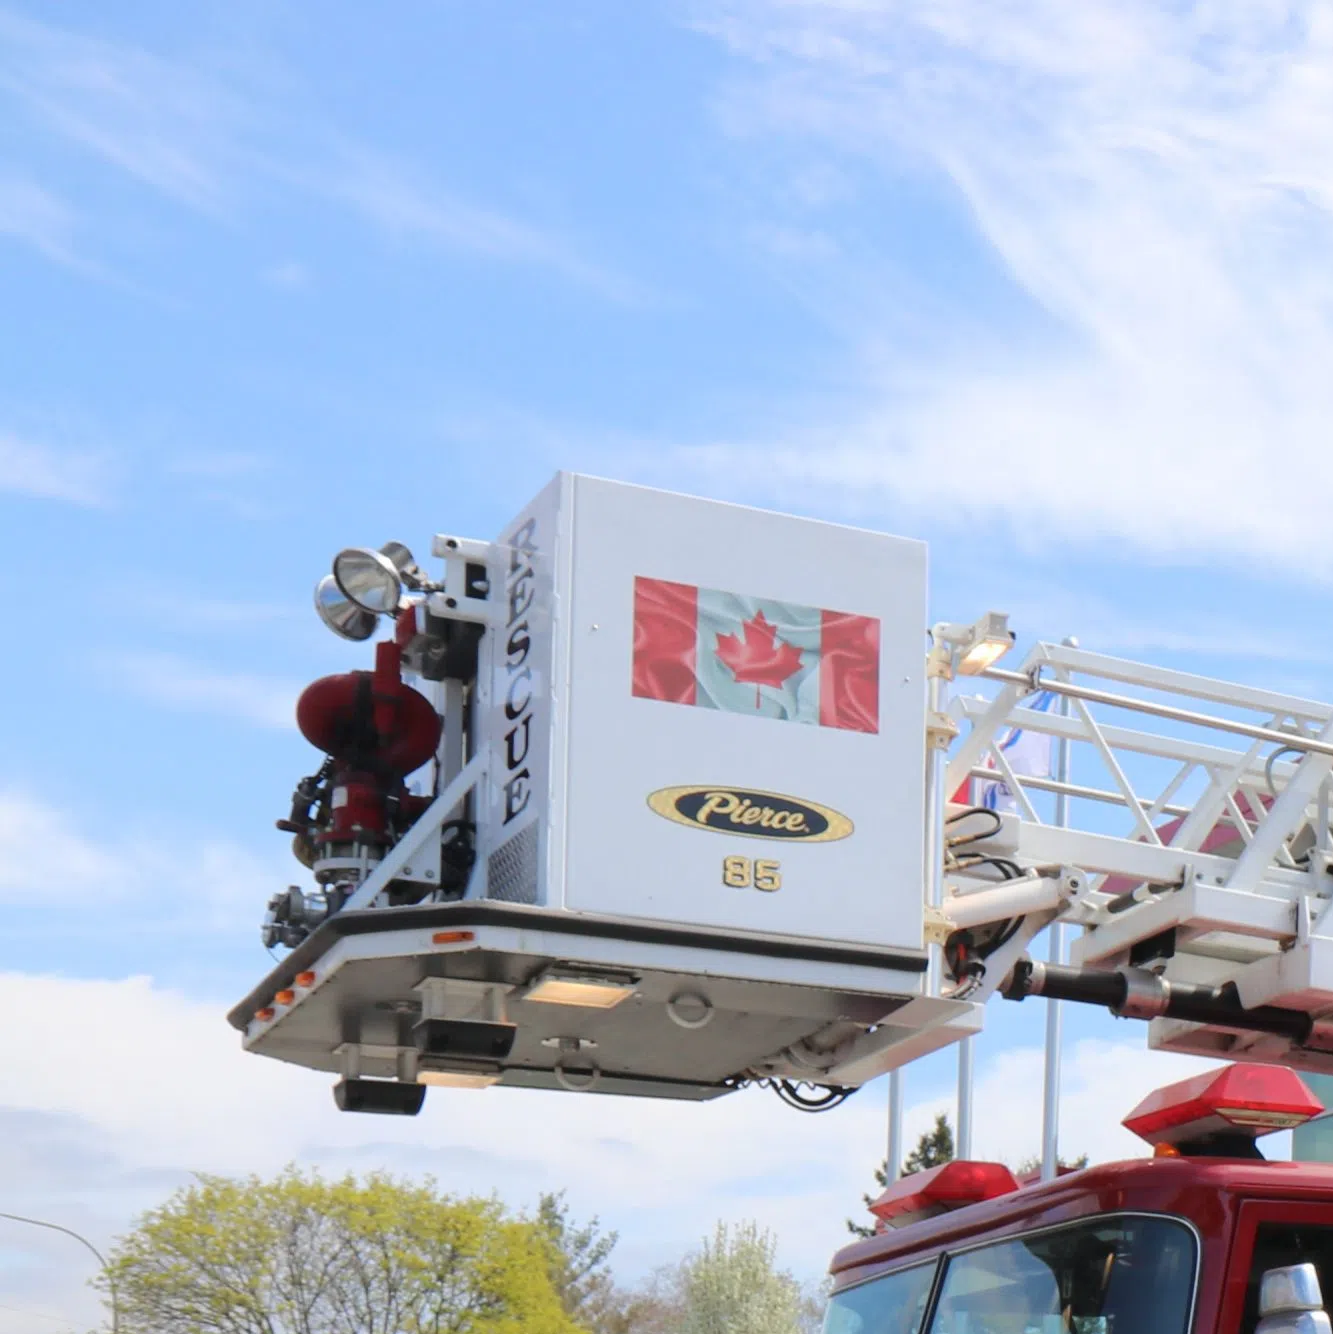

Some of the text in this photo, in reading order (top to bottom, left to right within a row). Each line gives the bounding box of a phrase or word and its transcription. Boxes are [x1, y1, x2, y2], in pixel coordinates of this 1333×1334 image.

[503, 518, 537, 826] RESCUE
[697, 792, 807, 832] Pierce
[723, 856, 781, 892] 85
